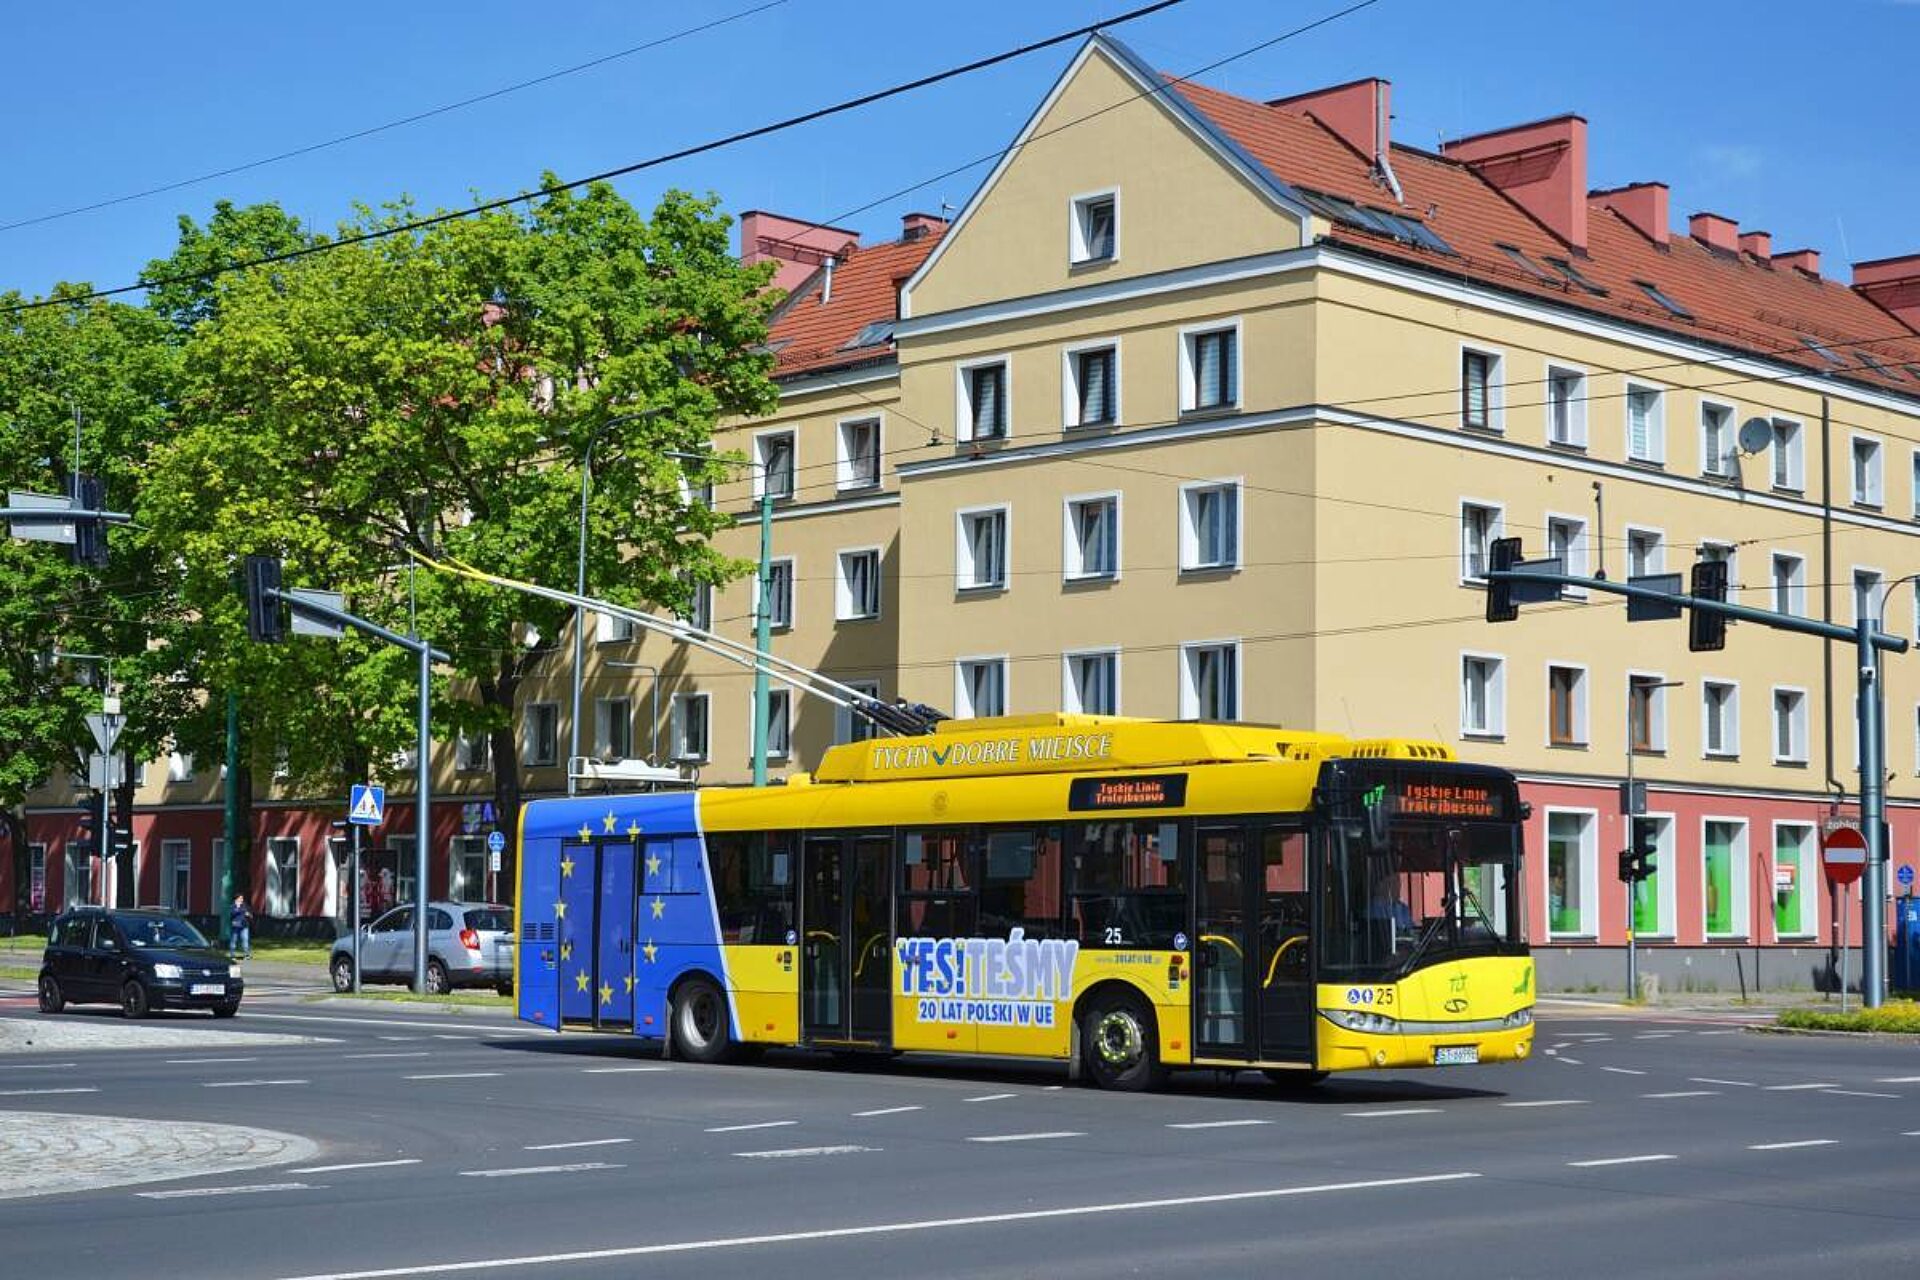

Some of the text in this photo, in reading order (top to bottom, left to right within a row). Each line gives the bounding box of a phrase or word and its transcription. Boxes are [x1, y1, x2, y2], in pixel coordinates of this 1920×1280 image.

[873, 733, 1113, 769] TYCHY DOBRE MIEJSCE
[1100, 781, 1162, 794] Tyskie Linie
[1407, 784, 1489, 801] Tyskie Linie
[1095, 792, 1165, 804] Trolejbusowe
[1398, 796, 1494, 816] Trolejbusowe
[1105, 927, 1122, 945] 25
[1376, 988, 1393, 1005] 25
[920, 1002, 1052, 1024] 20 LAT POLSKI W UE
